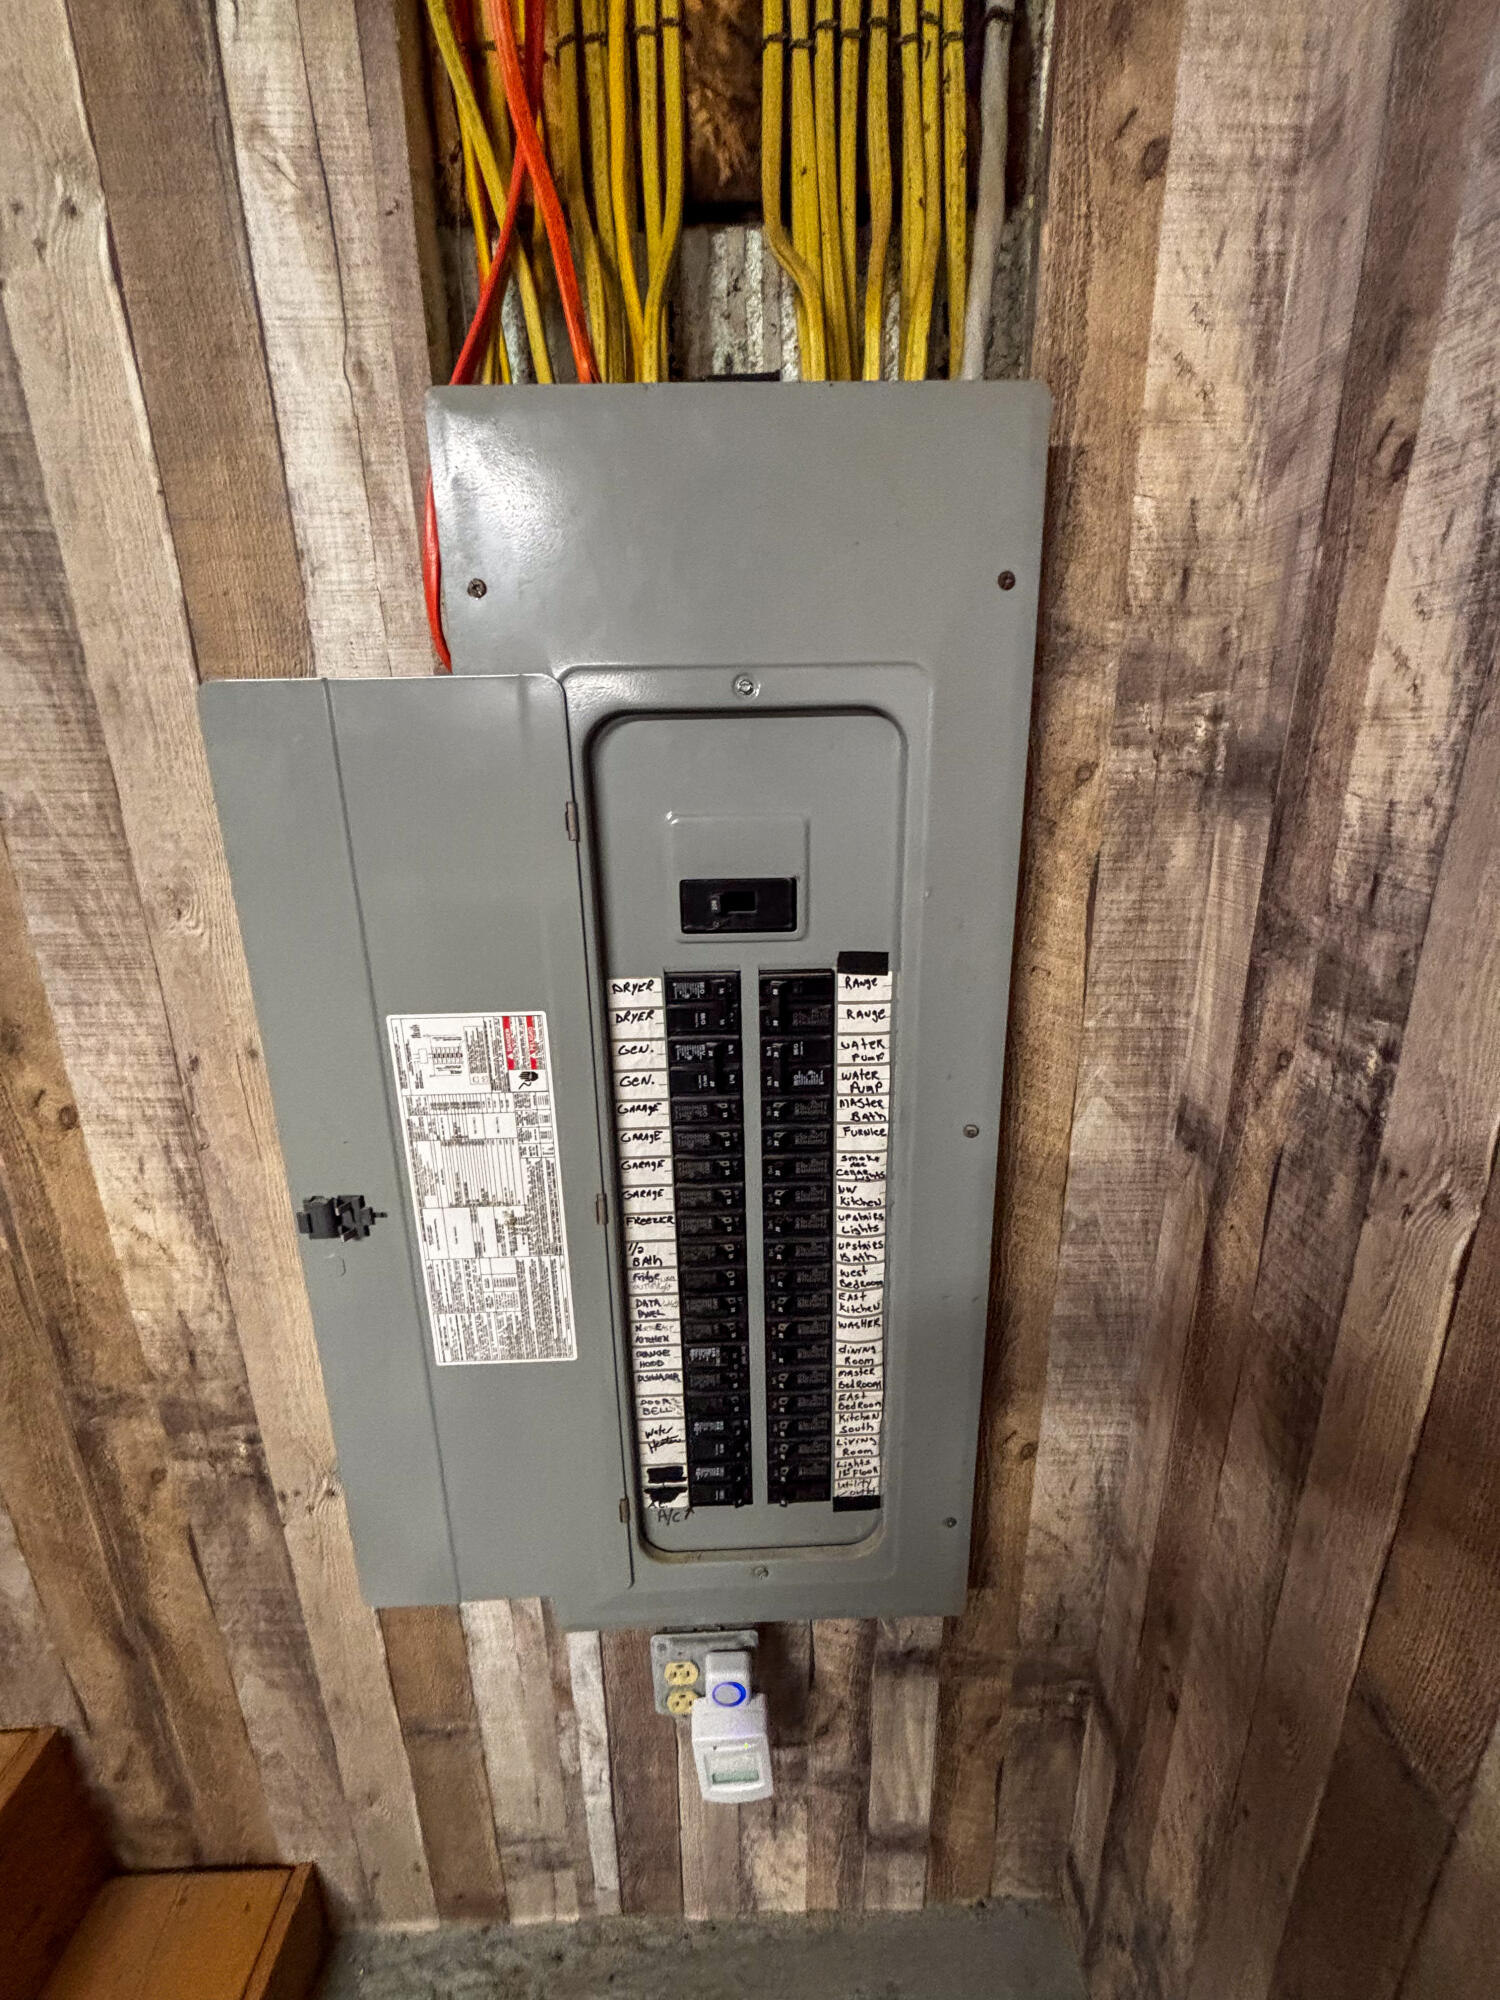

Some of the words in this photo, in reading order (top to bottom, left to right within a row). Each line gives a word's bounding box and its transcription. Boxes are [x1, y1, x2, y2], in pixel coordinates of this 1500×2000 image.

[612, 979, 655, 996] DRYER
[845, 975, 878, 990] RAnge
[615, 1009, 655, 1024] DRYER
[847, 1008, 887, 1023] RANge
[841, 1068, 881, 1081] WAteR
[839, 1097, 884, 1110] MASteR
[620, 1130, 663, 1143] GARAgE
[841, 1223, 880, 1235] Lights
[838, 1290, 868, 1301] EAst
[635, 1298, 662, 1308] DATA
[839, 1302, 881, 1314] KitcheN
[643, 1407, 673, 1416] BELL
[645, 1424, 674, 1440] Water
[840, 1422, 875, 1434] South
[842, 1447, 874, 1457] Room
[657, 1507, 681, 1527] A/C
